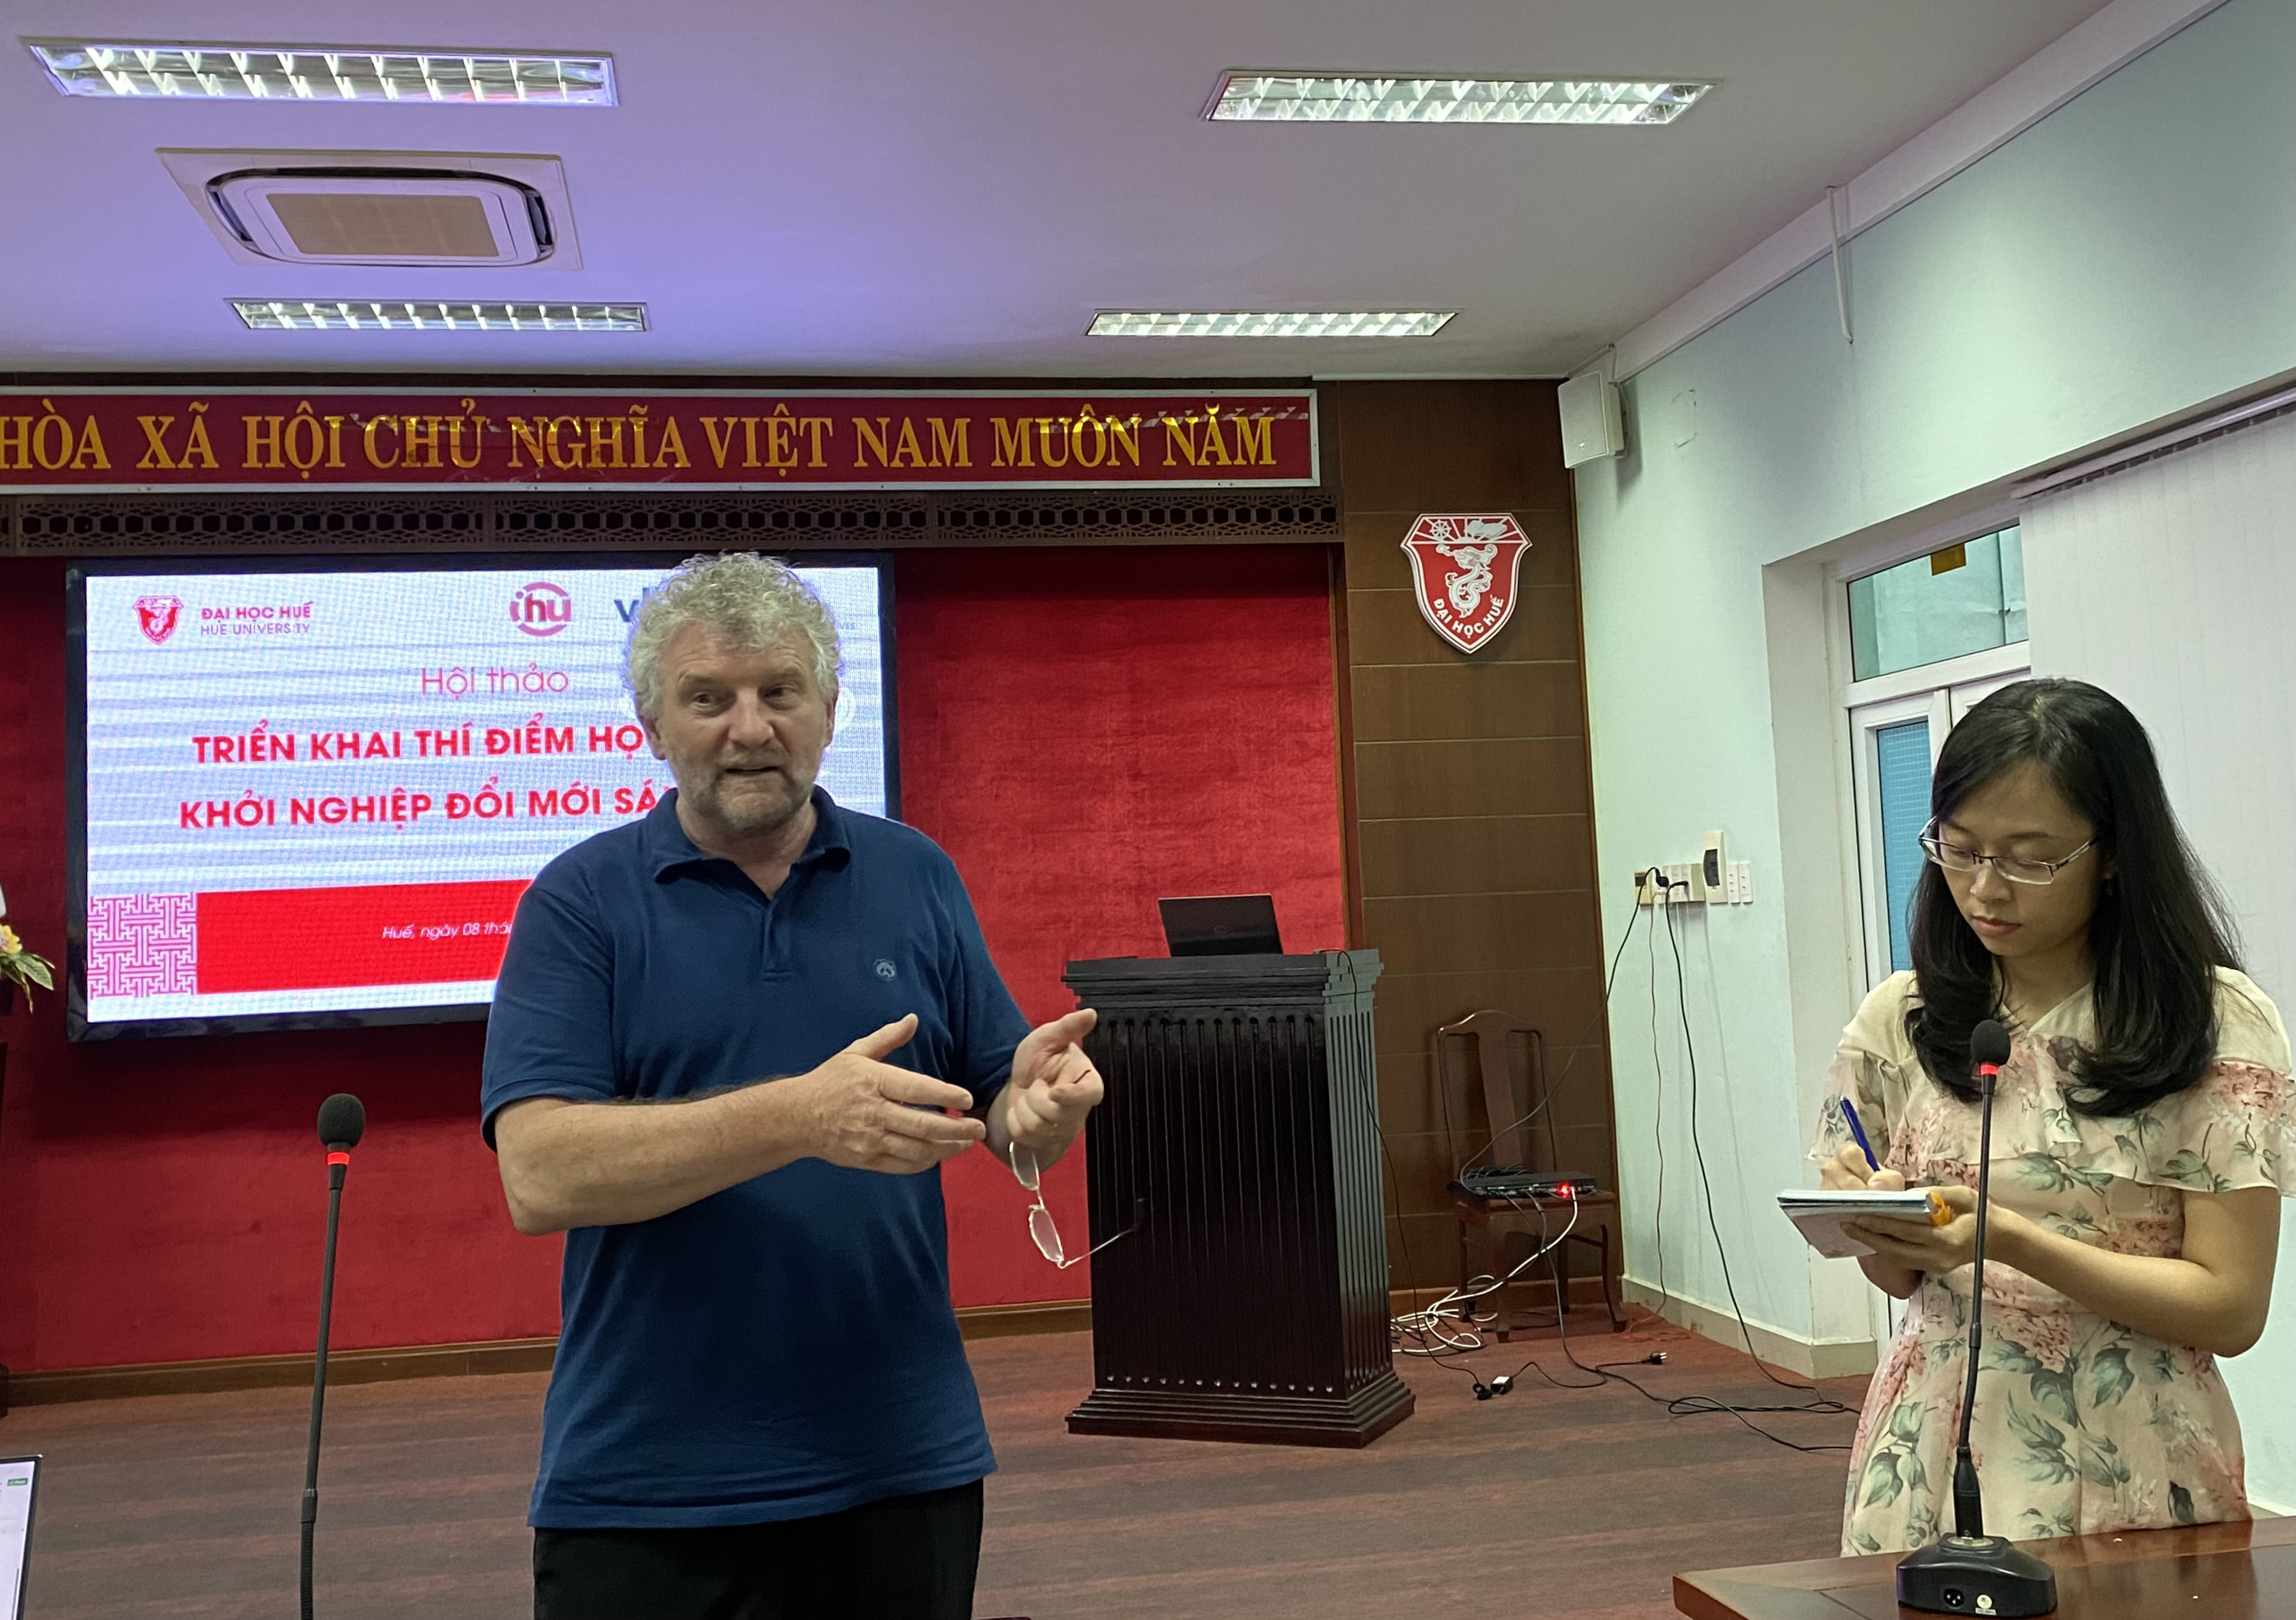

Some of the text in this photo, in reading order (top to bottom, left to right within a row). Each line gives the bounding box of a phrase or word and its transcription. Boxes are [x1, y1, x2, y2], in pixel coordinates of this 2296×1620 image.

[0, 399, 1276, 479] HÒA XÃ HỘI CHỦ NGHĨA VIỆT NAM MUÔN NĂM
[201, 601, 314, 623] ĐẠI HỌC HUẾ
[232, 622, 310, 635] UNIVERSTY
[1433, 594, 1504, 639] ĐẠI HỌC HUẾ
[422, 664, 569, 701] Hội thảo
[192, 719, 296, 764] TRIỂN
[310, 731, 402, 760] KHAI
[414, 721, 473, 758] THÍ
[484, 713, 575, 756] ĐIỂM
[180, 776, 670, 831] KHỞI NGHIỆP ĐỔI MỚI SÁ
[420, 923, 460, 941] ngày
[462, 922, 481, 936] 08
